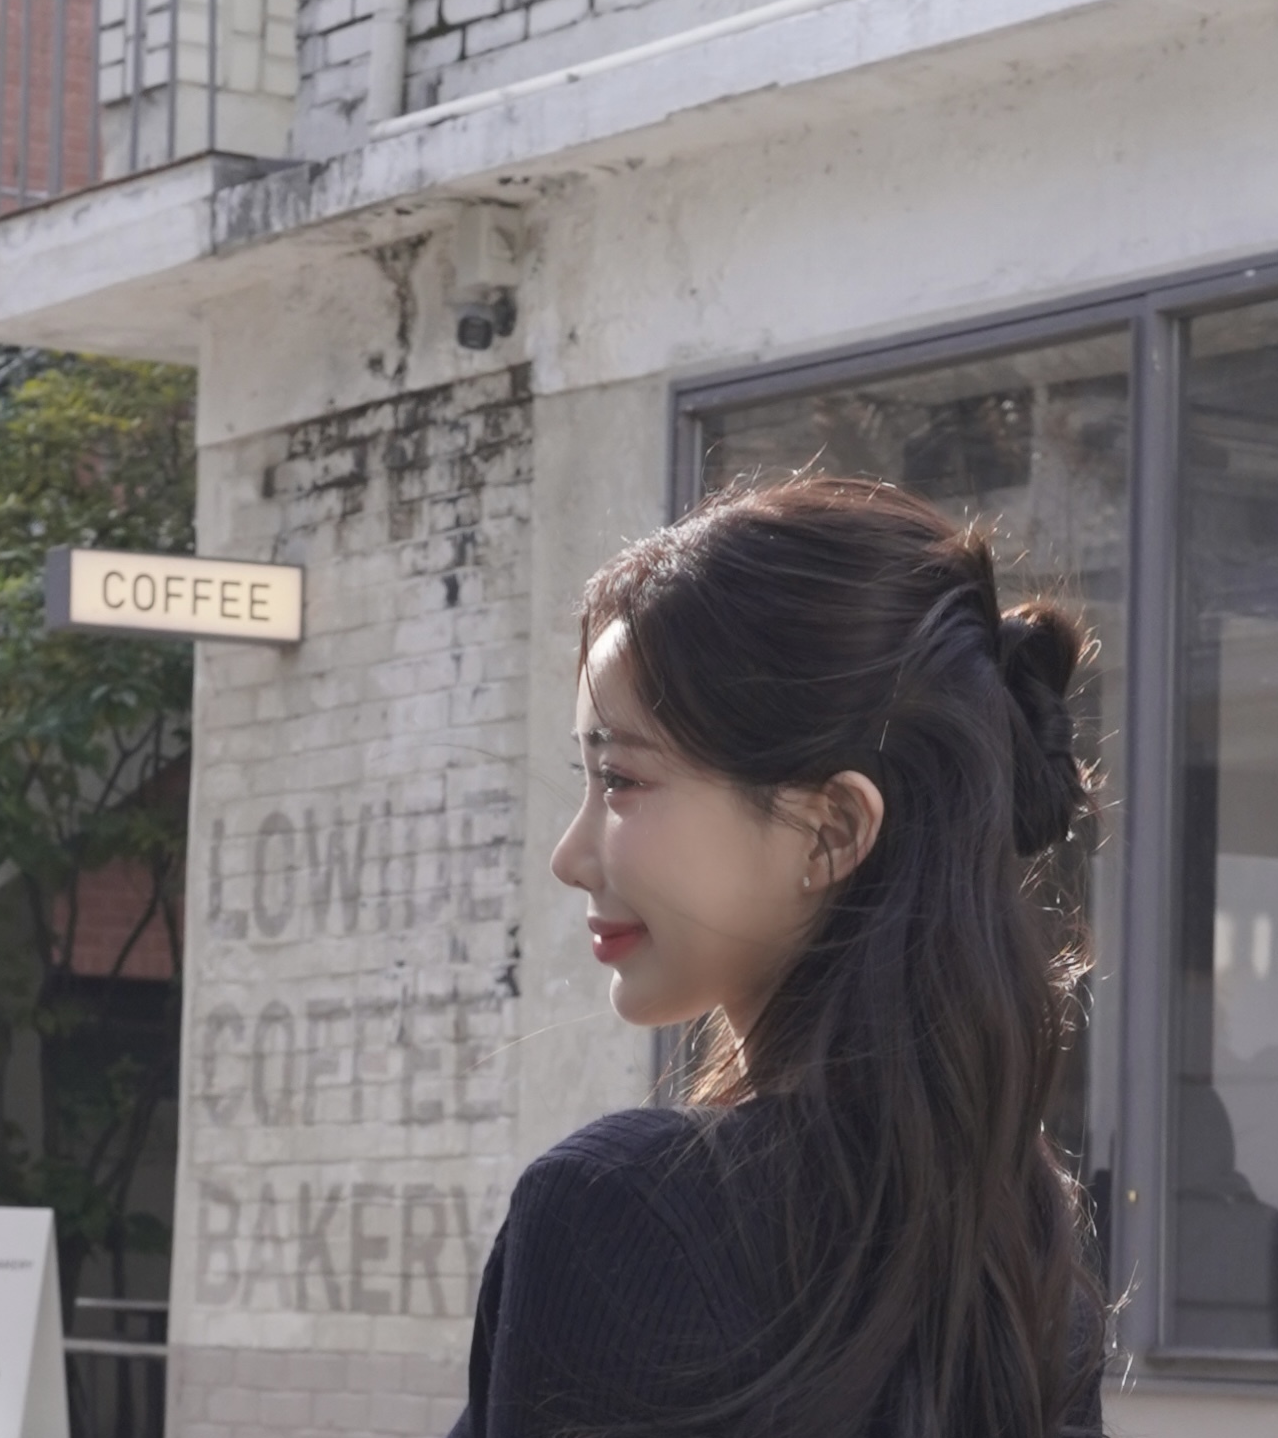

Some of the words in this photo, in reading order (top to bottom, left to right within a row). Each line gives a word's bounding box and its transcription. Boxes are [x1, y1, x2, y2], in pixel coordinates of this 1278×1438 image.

[102, 569, 271, 622] COFFEE
[202, 998, 506, 1127] COFFEE
[195, 1178, 502, 1318] BAKERY
